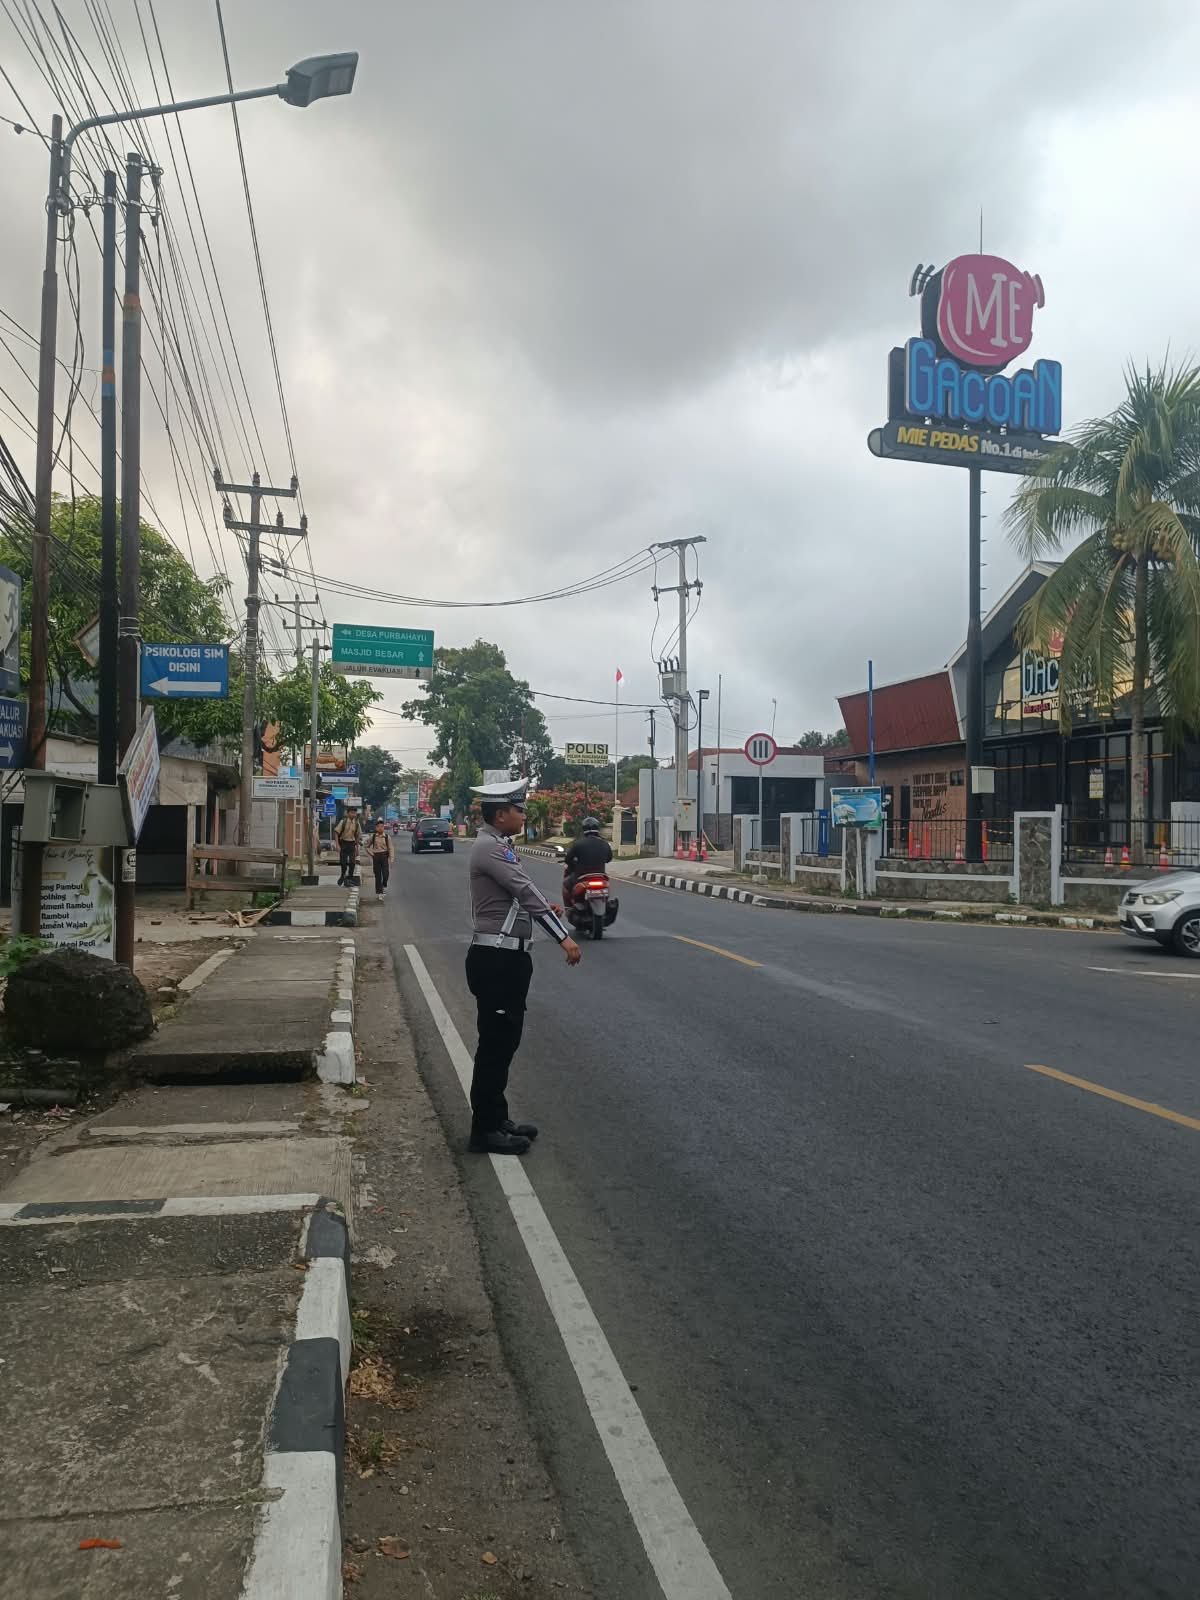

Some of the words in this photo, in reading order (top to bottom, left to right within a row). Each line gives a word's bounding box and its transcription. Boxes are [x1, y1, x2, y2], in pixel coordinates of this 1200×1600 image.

[911, 341, 1061, 429] GACOAN
[897, 426, 928, 446] MIE
[929, 431, 979, 453] PEDAS
[355, 629, 377, 639] DESA
[145, 647, 200, 658] PSIKOLOGI
[204, 648, 223, 659] SIM
[340, 647, 372, 657] MASJID
[375, 650, 404, 659] BESAR
[169, 662, 200, 673] DISINI
[344, 665, 367, 673] JALUR
[567, 743, 608, 754] POLISI
[66, 901, 93, 909] Rambut
[42, 912, 69, 920] Rambut
[66, 921, 88, 930] Wajah
[79, 939, 96, 947] Pedi
